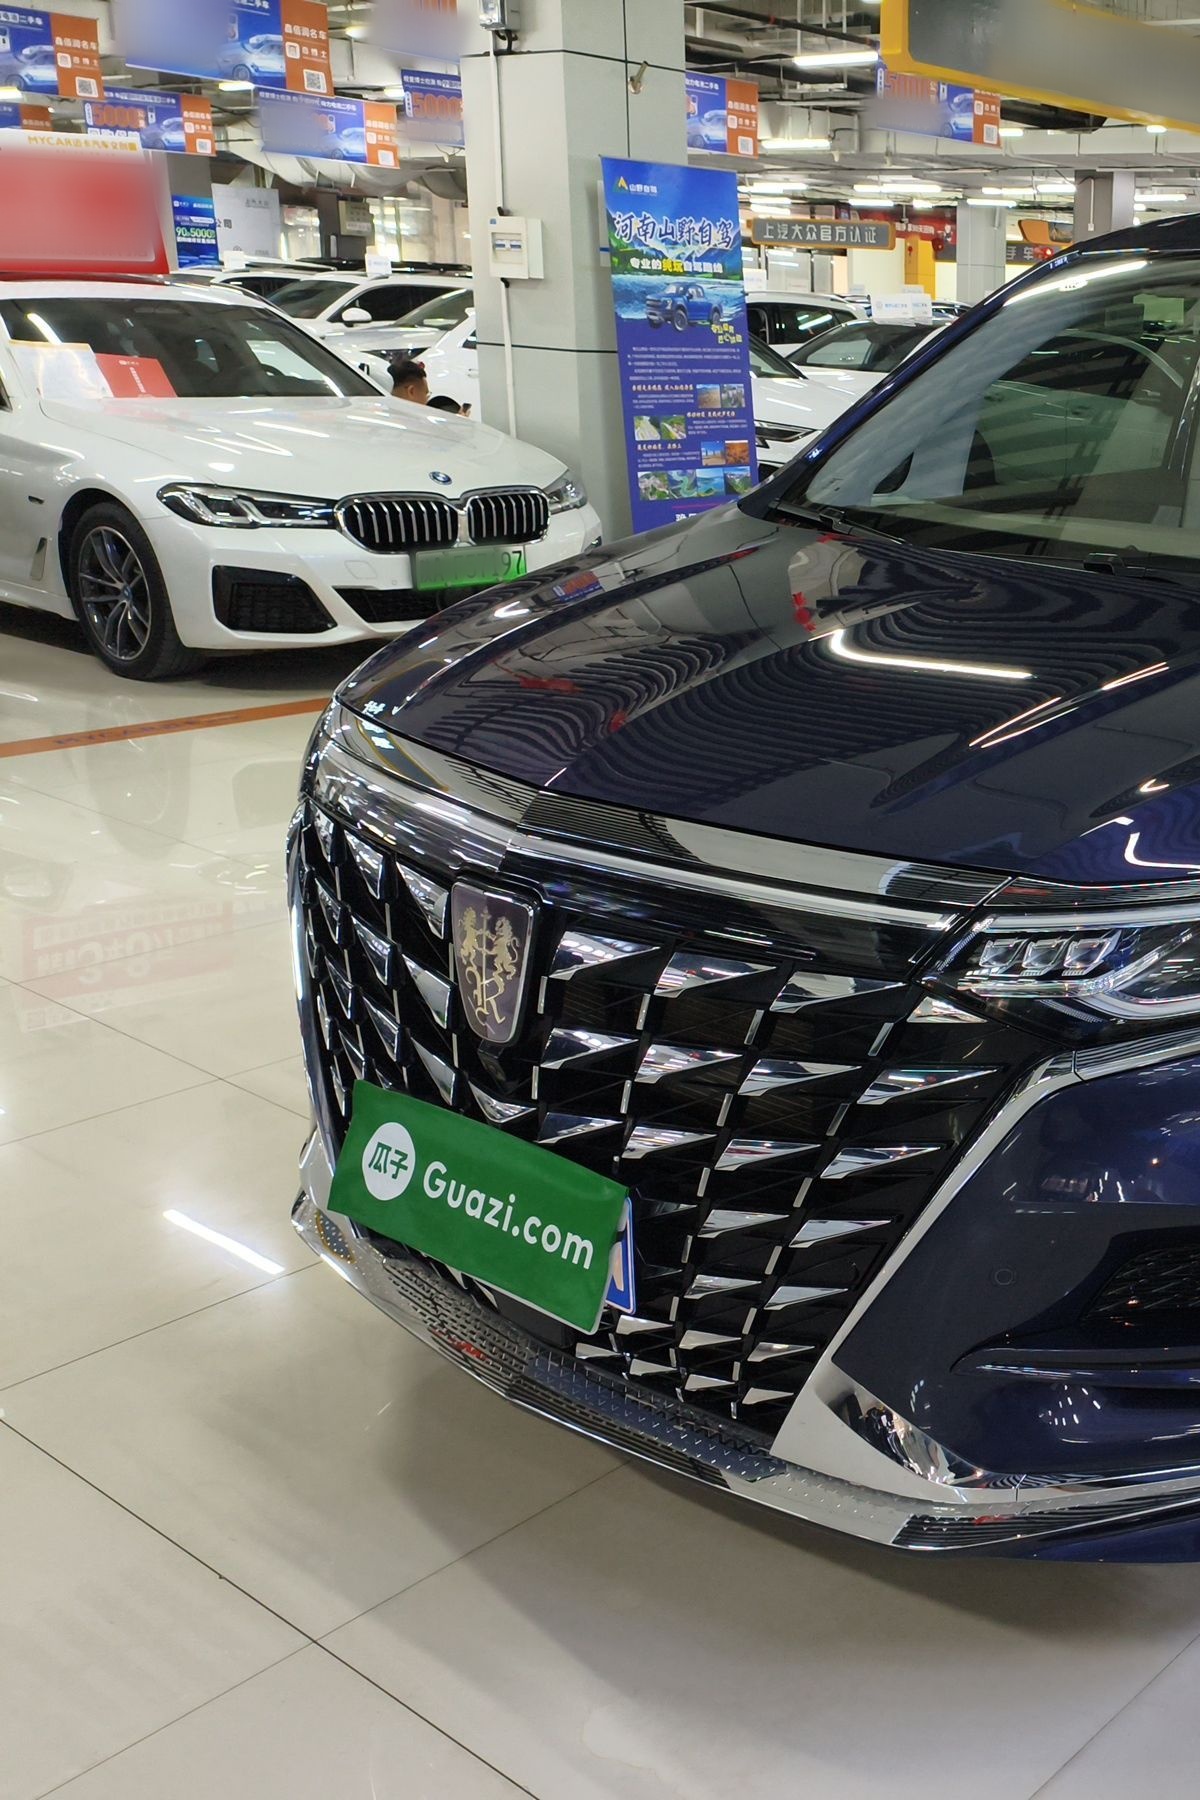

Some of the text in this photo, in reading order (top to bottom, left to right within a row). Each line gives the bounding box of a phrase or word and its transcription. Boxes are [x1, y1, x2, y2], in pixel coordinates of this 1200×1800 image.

[614, 211, 733, 248] 河南山野自驾
[763, 221, 878, 244] 上汽大众官方认证
[367, 1141, 409, 1180] 瓜子
[423, 1161, 594, 1270] Guazi.com
